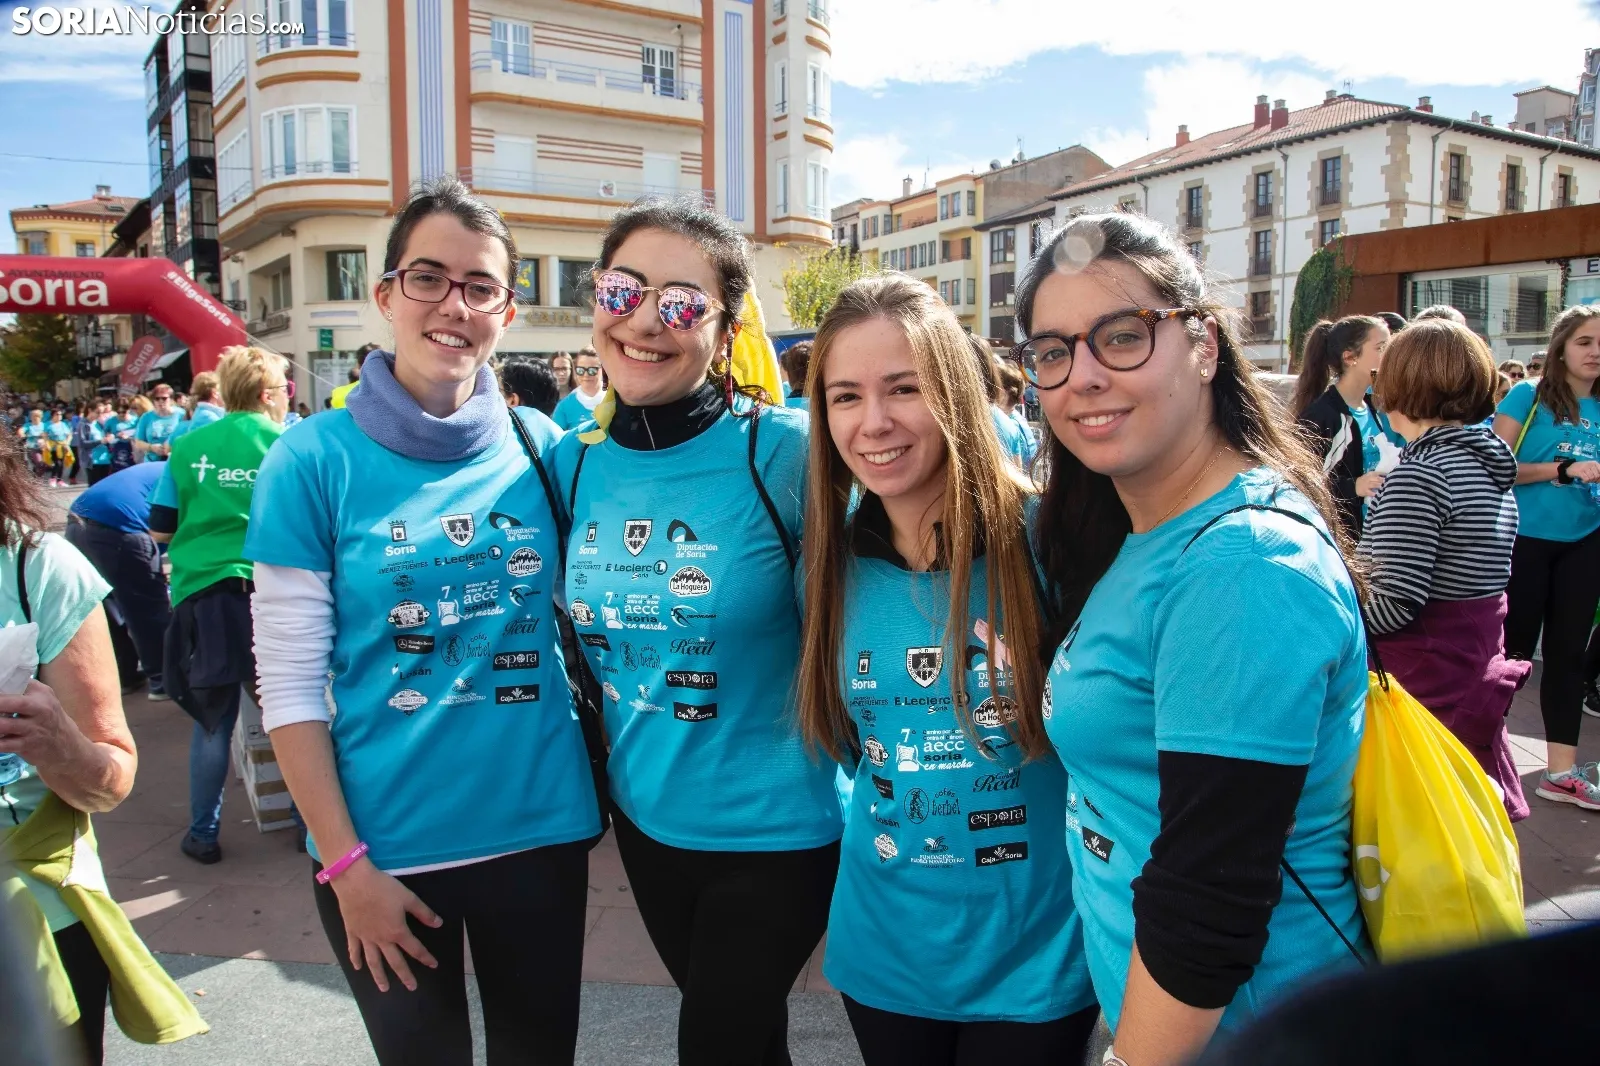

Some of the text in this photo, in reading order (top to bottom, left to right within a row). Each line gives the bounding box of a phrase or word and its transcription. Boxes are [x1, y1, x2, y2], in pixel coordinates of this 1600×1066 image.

[127, 343, 155, 376] Soria
[217, 468, 259, 482] aec
[506, 532, 534, 542] de Soria
[384, 545, 417, 557] Soria
[578, 546, 598, 556] Soria
[676, 543, 718, 553] Diputación
[434, 552, 487, 567] E.Leclerc
[605, 563, 652, 572] E.Leclerc
[672, 582, 708, 592] La Hoguera
[463, 589, 499, 605] aecc
[464, 600, 496, 612] soria
[475, 605, 506, 617] marcha
[624, 604, 660, 615] aecc
[626, 614, 658, 622] soria
[503, 618, 540, 637] Real
[638, 621, 668, 630] marcha
[670, 638, 716, 656] Real
[494, 652, 537, 668] espora
[400, 667, 432, 680] Losán
[667, 672, 715, 686] espora
[852, 678, 877, 690] Soria
[978, 680, 988, 688] de
[894, 696, 951, 706] E.Leclerc
[677, 711, 689, 720] Caja
[978, 714, 986, 722] La
[924, 740, 965, 752] aecc
[924, 752, 962, 762] soria
[924, 757, 974, 771] en marcha
[972, 767, 1021, 793] Real
[876, 812, 900, 828] Losán
[970, 808, 1024, 827] espora
[981, 856, 996, 864] Caja
